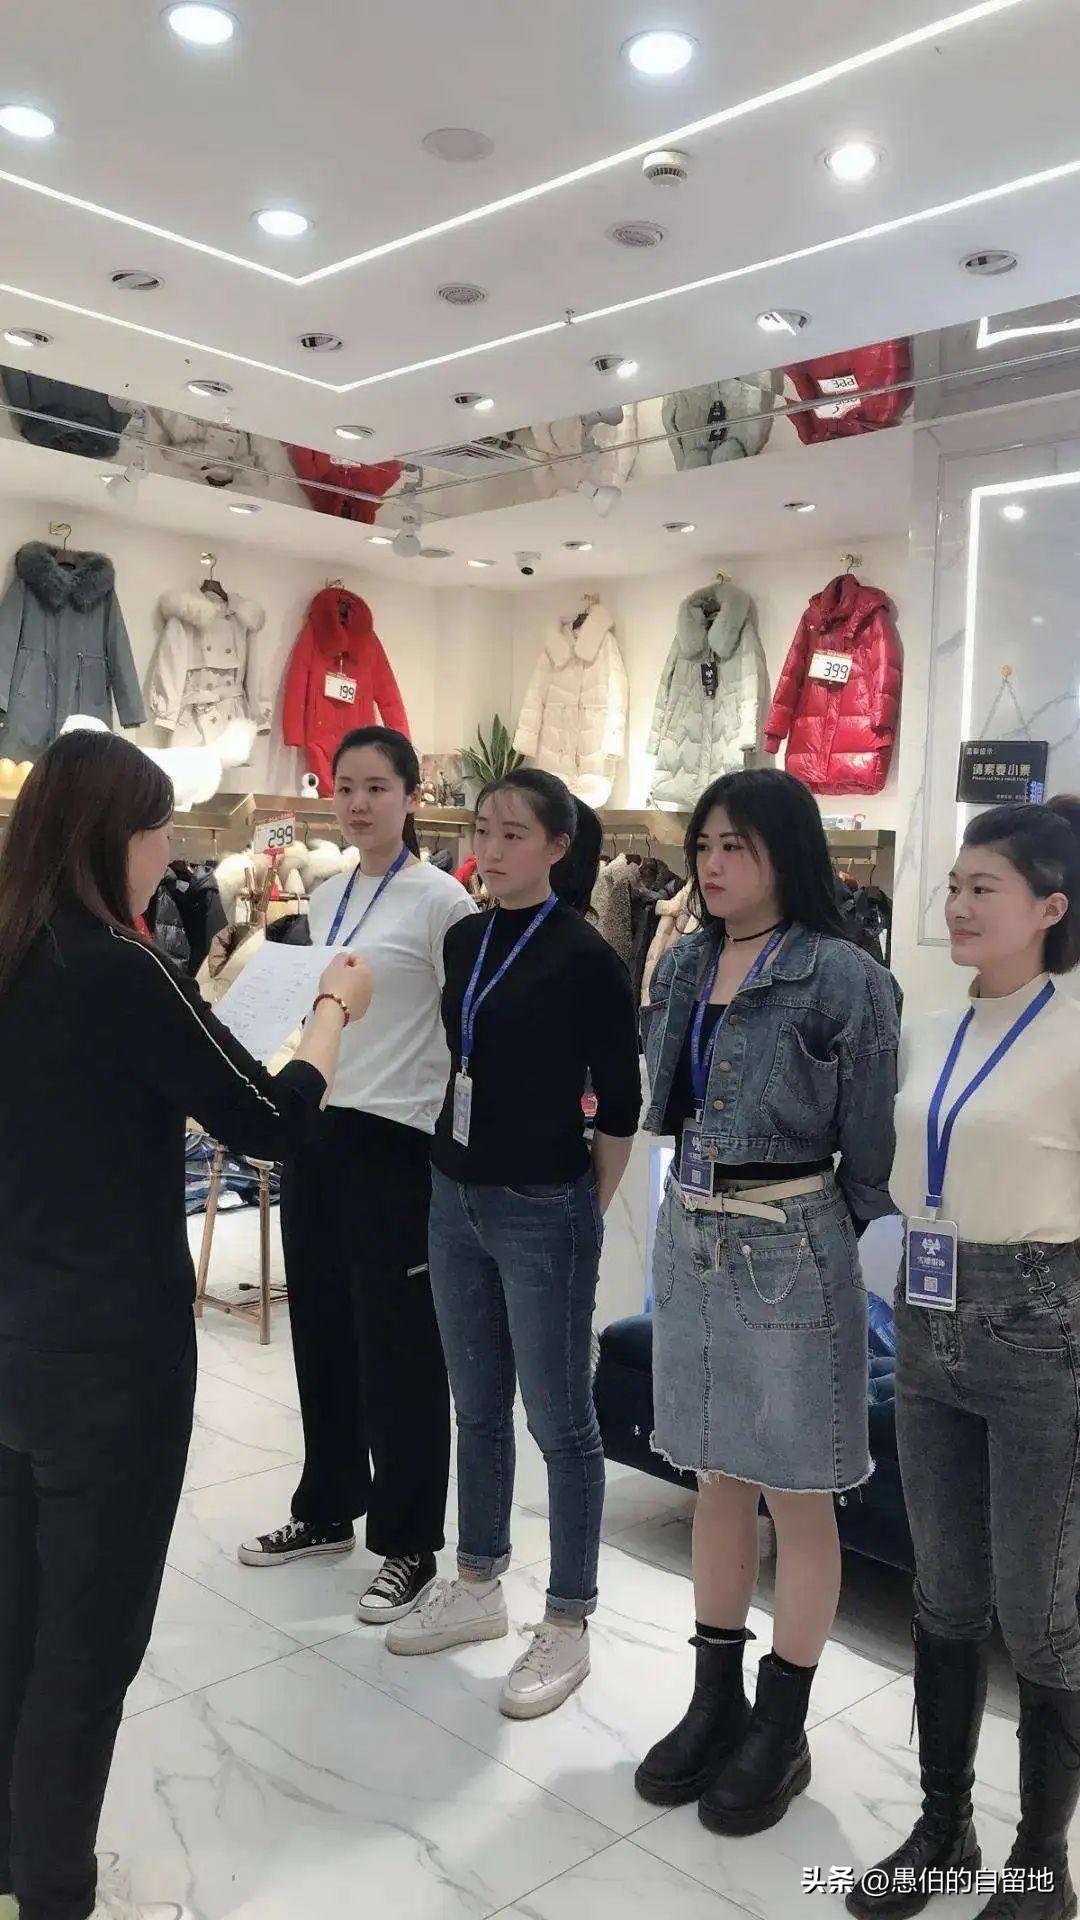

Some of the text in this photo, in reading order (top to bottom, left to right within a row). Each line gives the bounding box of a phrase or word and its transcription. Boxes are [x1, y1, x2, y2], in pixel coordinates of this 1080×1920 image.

[824, 661, 849, 680] 399
[340, 685, 355, 701] 199
[972, 763, 1031, 776] 请索要小票
[268, 825, 293, 849] 299
